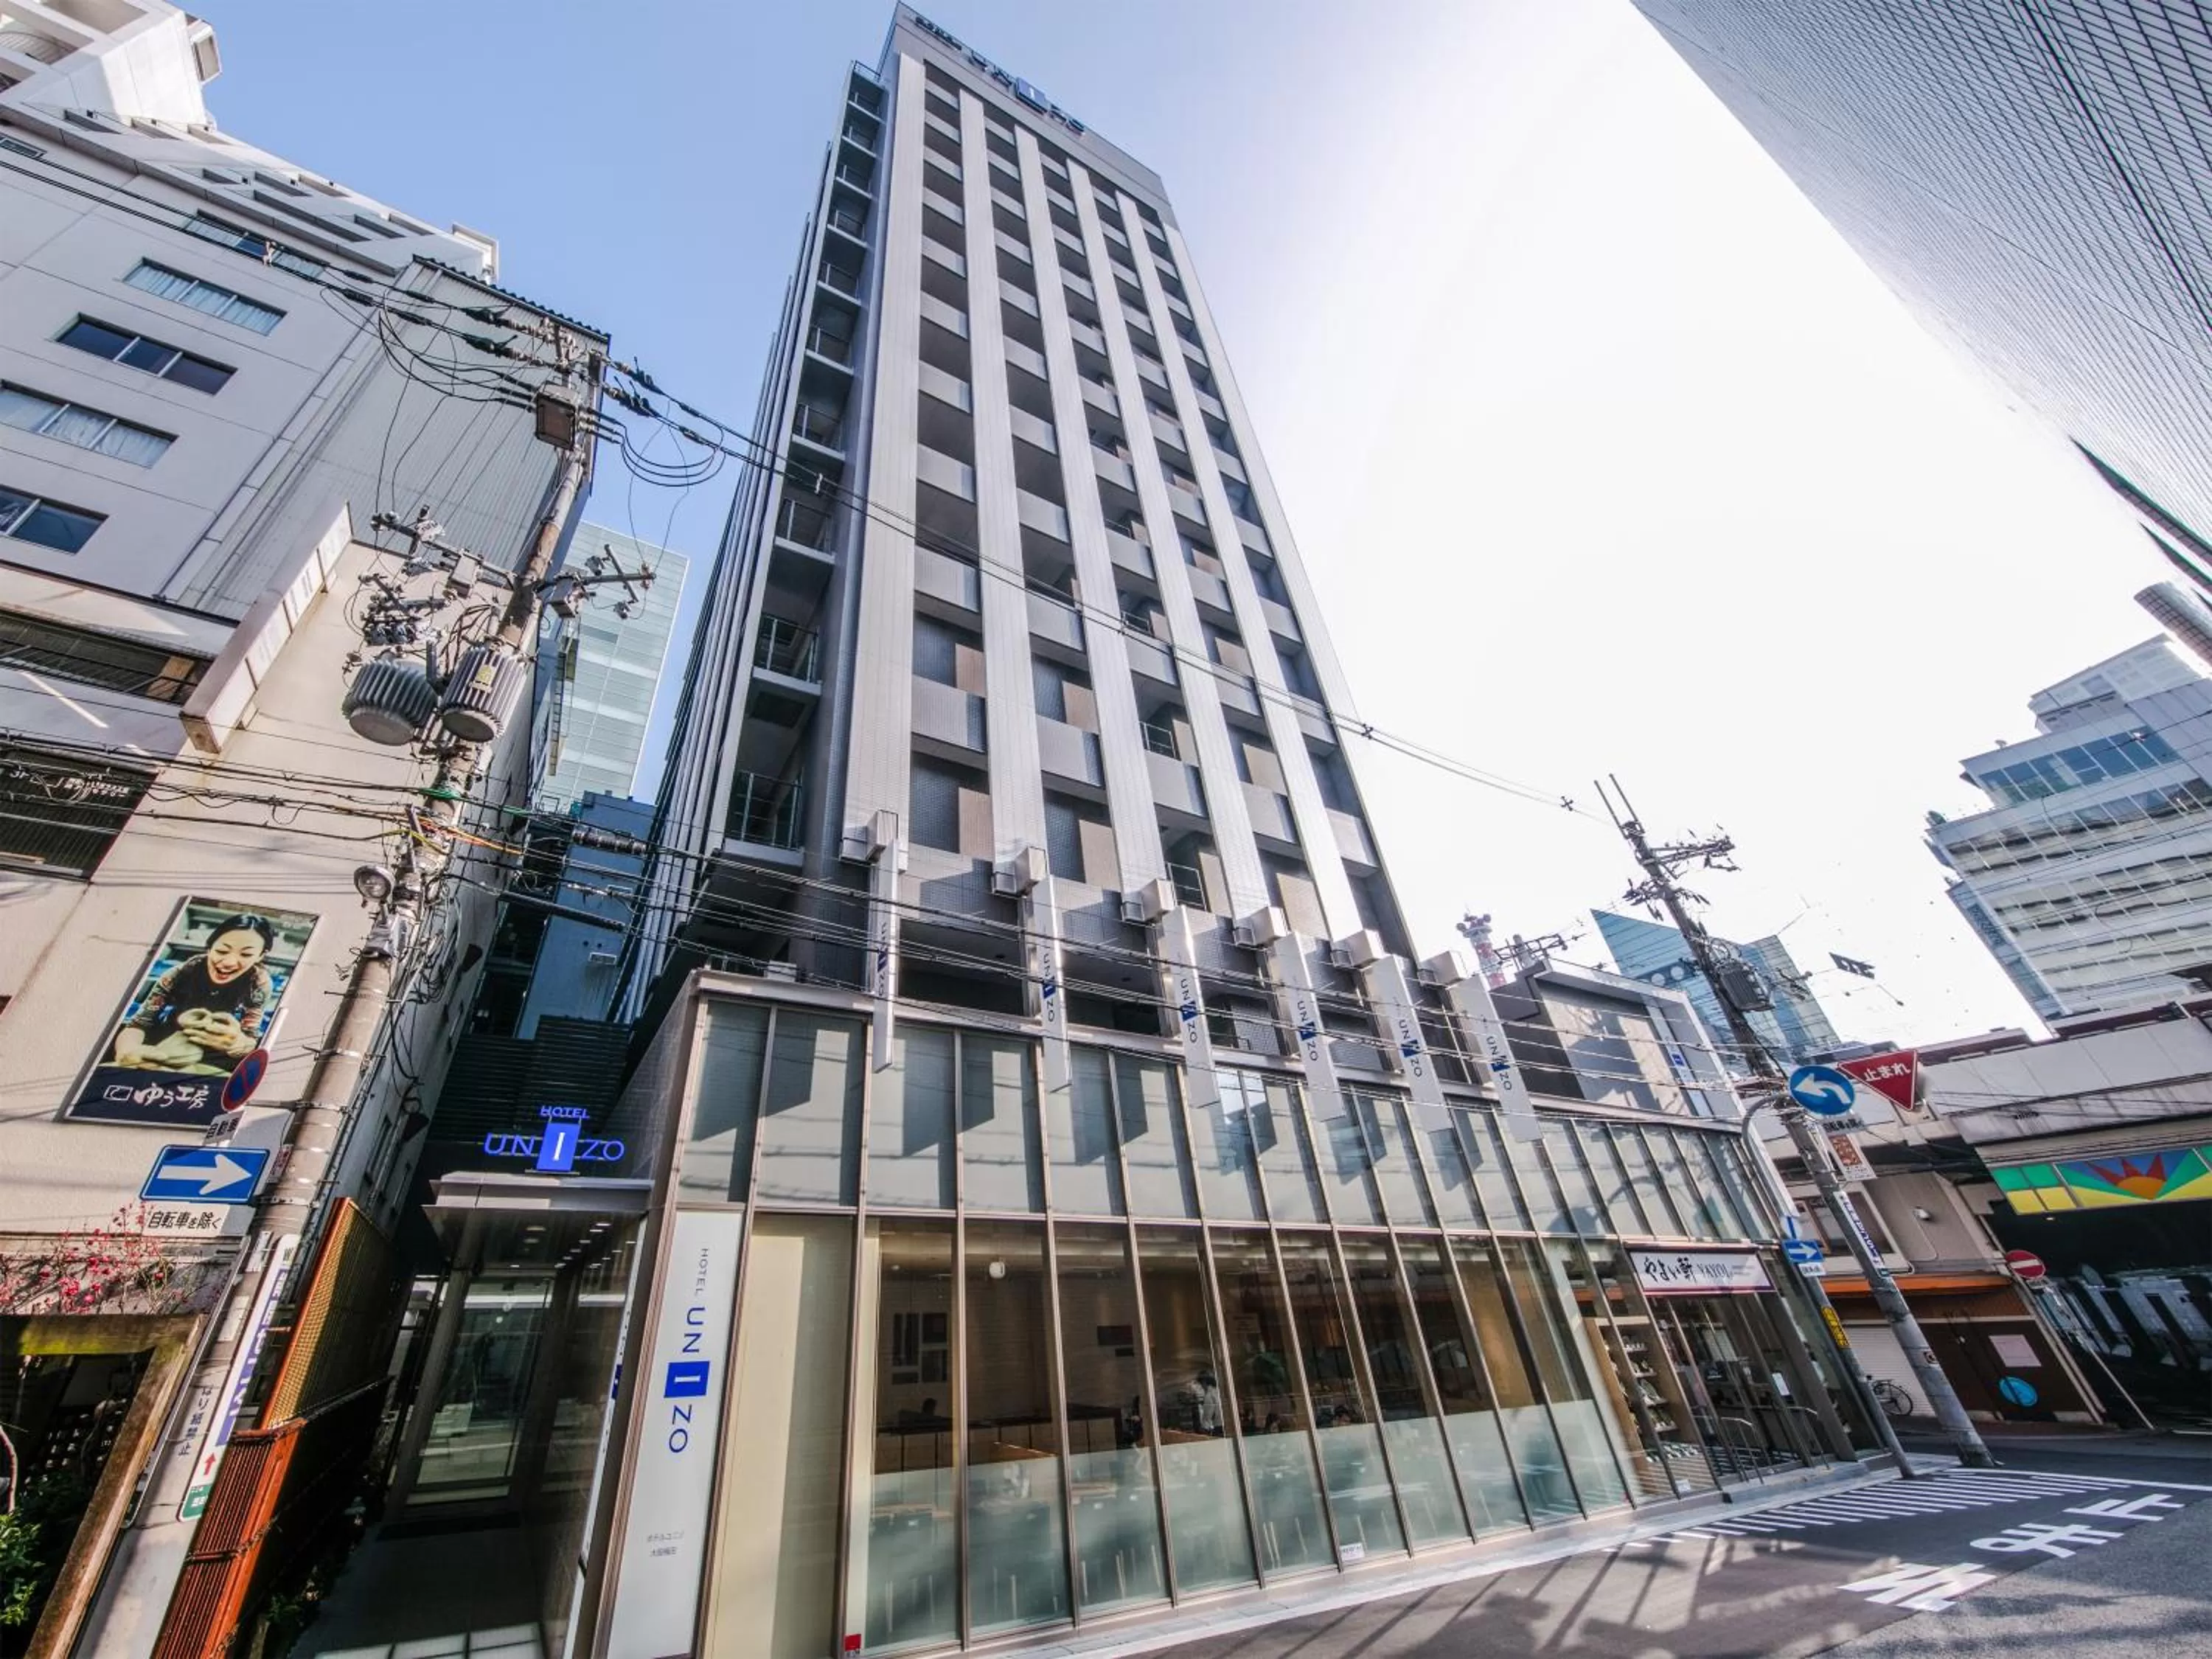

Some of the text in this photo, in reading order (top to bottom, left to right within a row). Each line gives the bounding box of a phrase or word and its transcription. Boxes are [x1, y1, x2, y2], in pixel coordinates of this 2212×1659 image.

[1864, 1062, 1912, 1082] 止まれ
[133, 1081, 209, 1110] ゆう工房
[540, 1105, 590, 1119] HOTEL
[483, 1130, 627, 1163] UNIZO
[147, 1211, 223, 1230] 自転車を除く
[1644, 1256, 1696, 1282] やよい軒
[667, 1248, 709, 1453] HOTEL UNIZO
